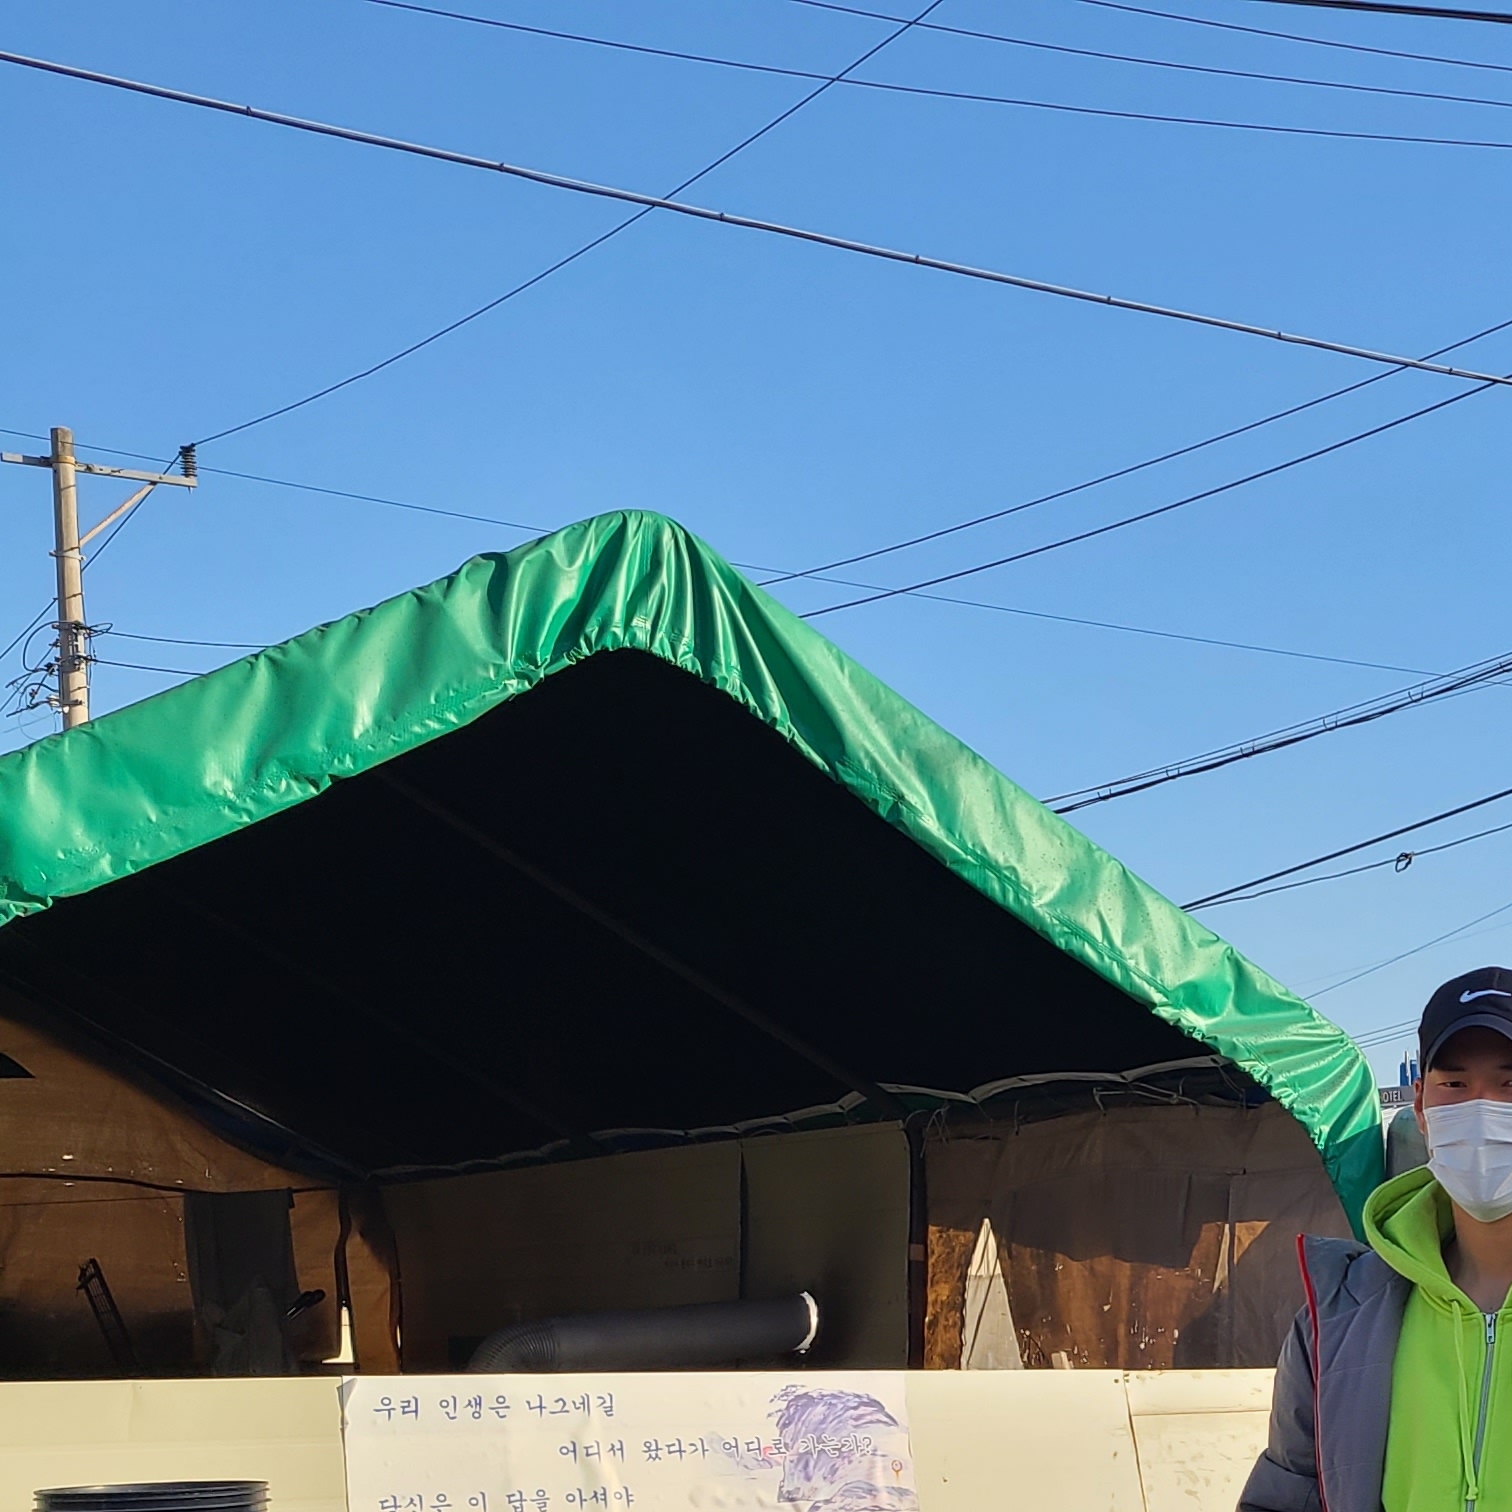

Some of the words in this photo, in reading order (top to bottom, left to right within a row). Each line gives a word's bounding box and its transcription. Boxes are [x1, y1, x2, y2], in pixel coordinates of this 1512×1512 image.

[1380, 1090, 1402, 1103] OTEL
[372, 1395, 420, 1421] 우리
[438, 1394, 511, 1421] 인생은
[525, 1392, 615, 1419] 나그네길
[558, 1440, 626, 1464] 어디서
[641, 1437, 710, 1463] 왔다가
[721, 1436, 788, 1460] 어디로
[799, 1434, 874, 1457] 가는가?
[565, 1485, 635, 1511] 아셔야
